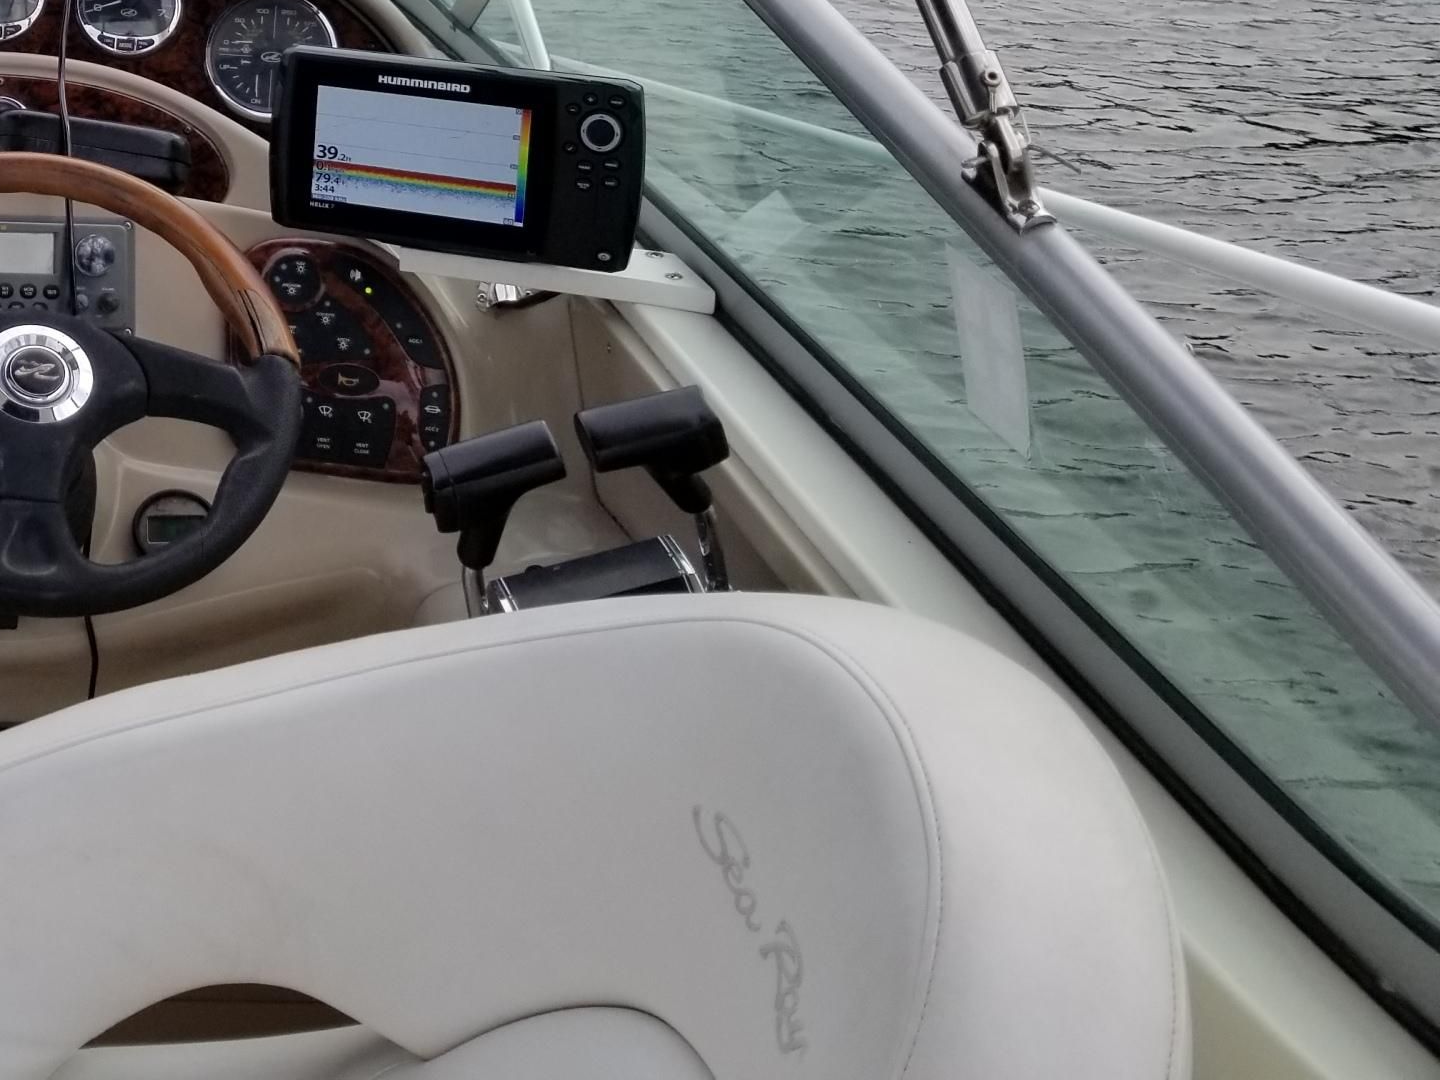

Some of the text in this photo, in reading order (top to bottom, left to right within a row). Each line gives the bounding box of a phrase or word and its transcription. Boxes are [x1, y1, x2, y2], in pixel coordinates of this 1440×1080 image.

[377, 74, 472, 94] HUMMINBIRD
[314, 183, 335, 193] 3:44
[691, 803, 810, 1056] Sea Ray
